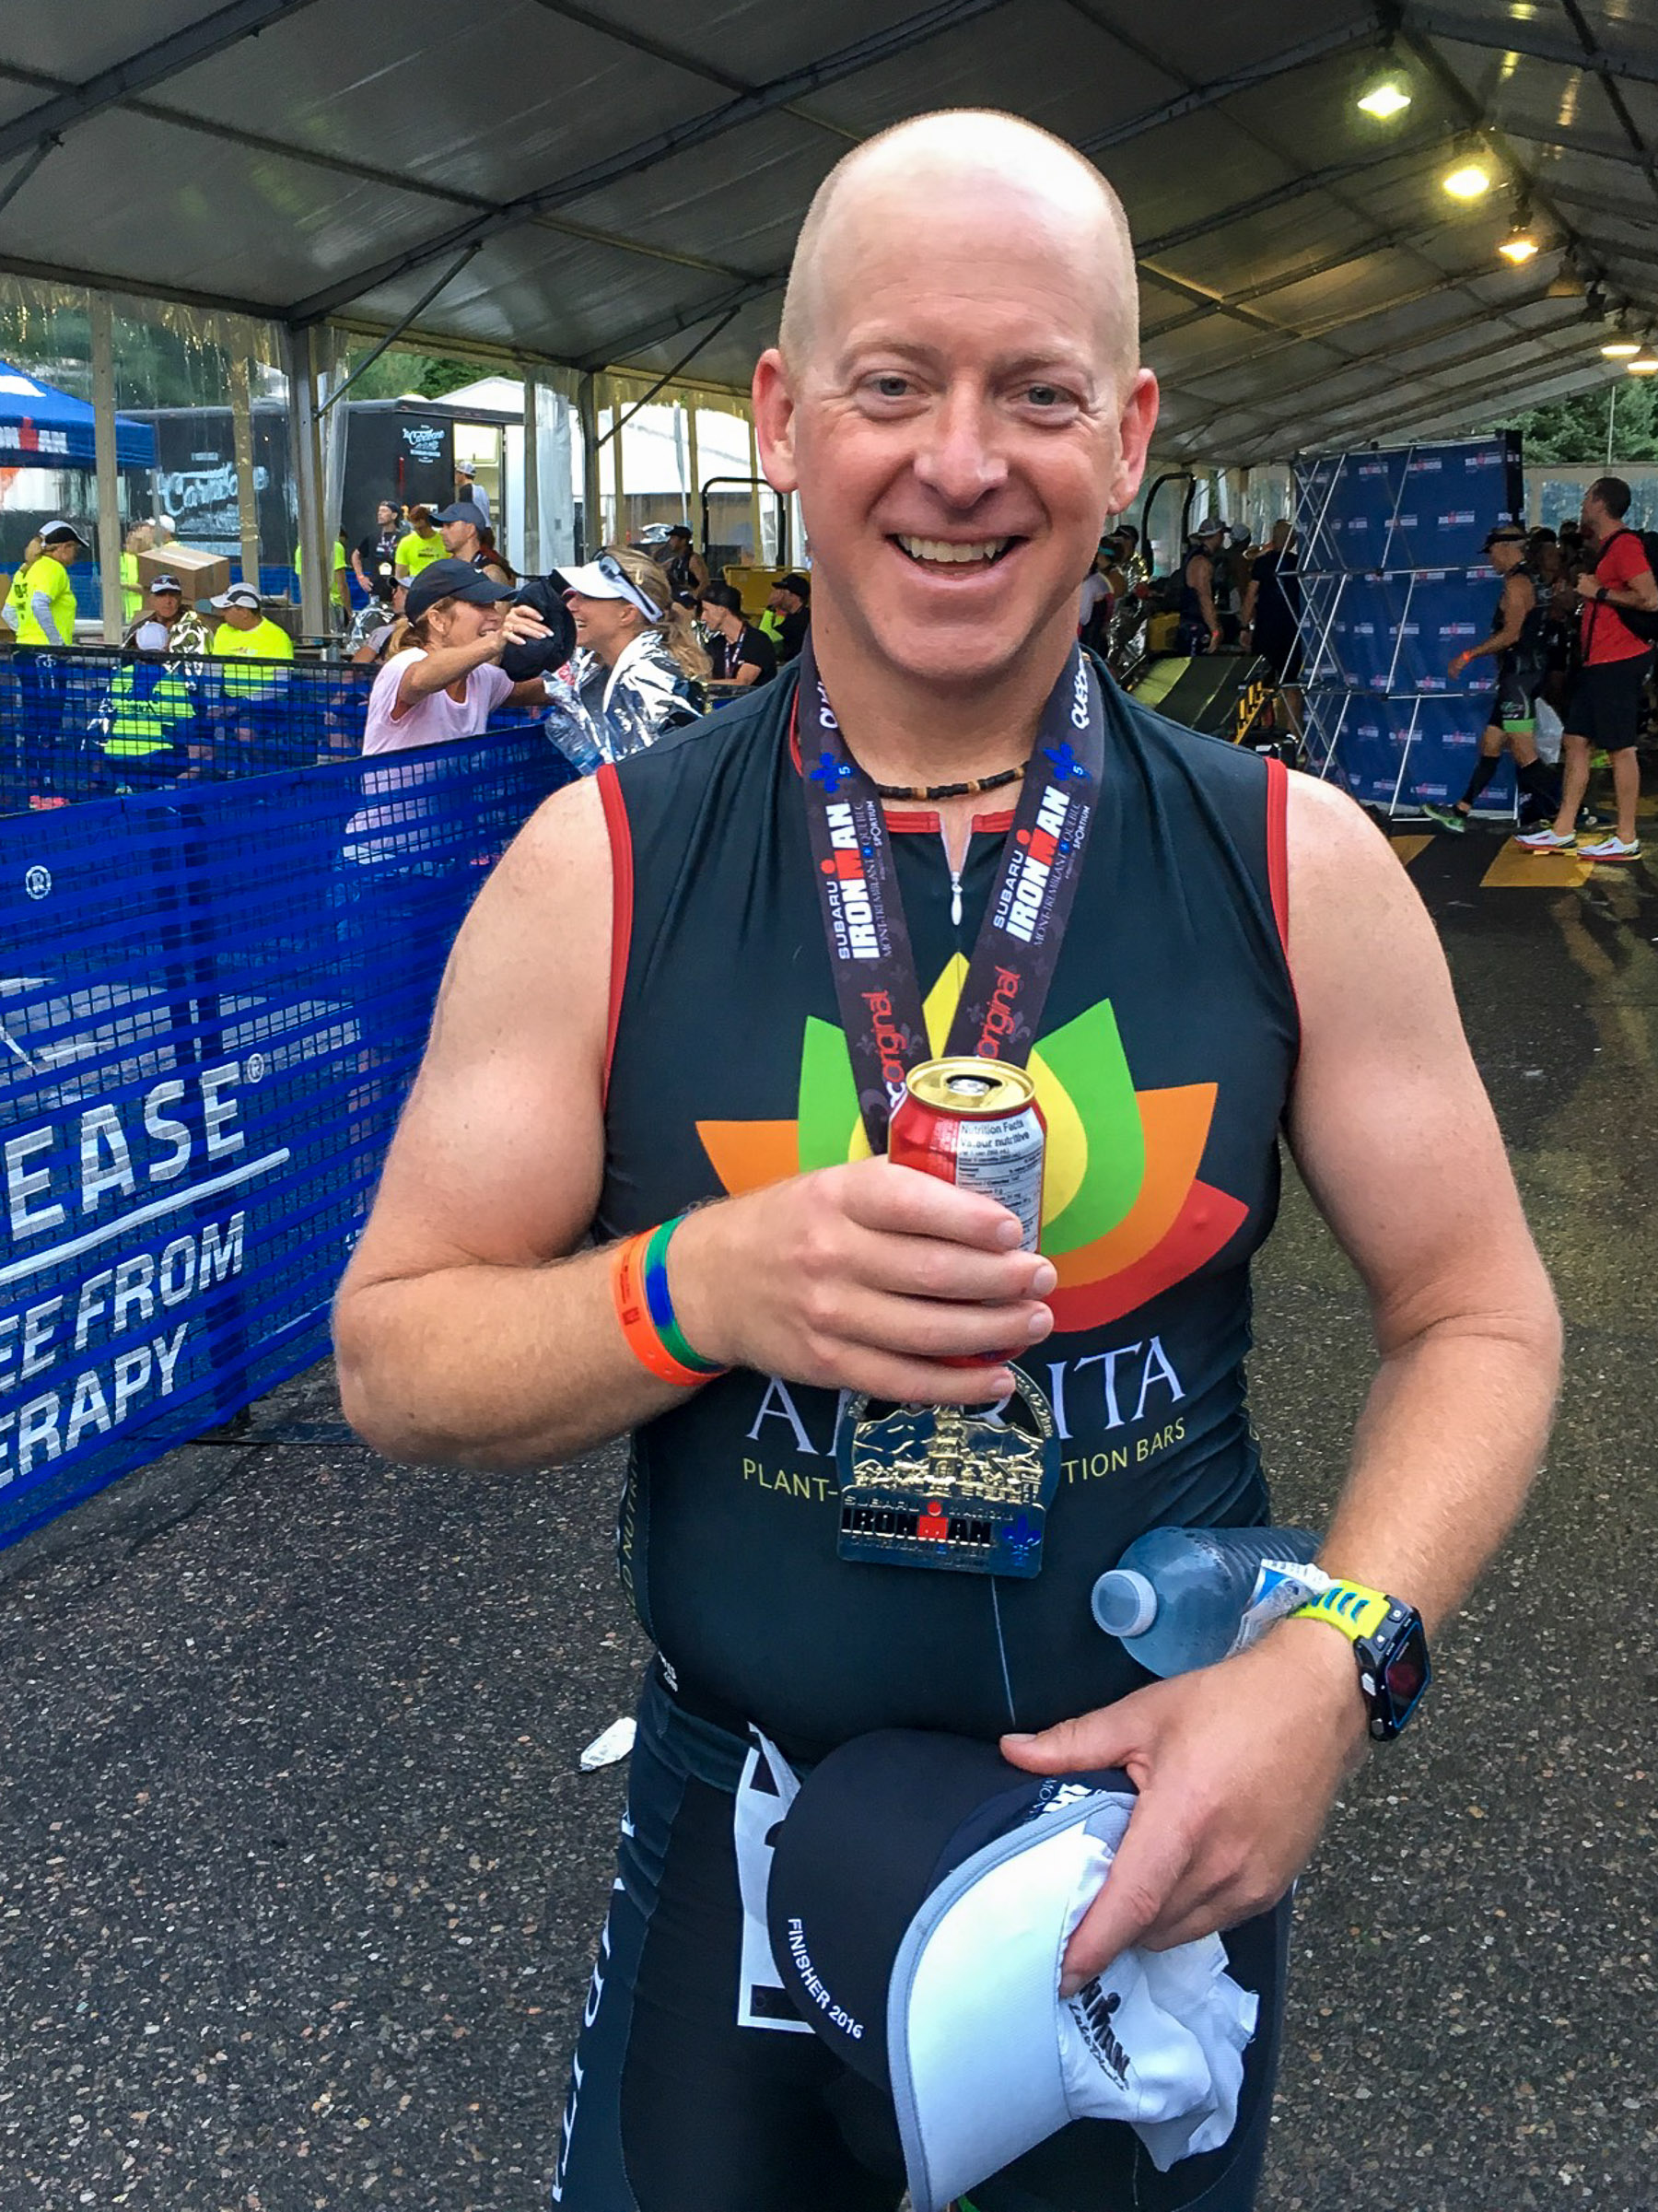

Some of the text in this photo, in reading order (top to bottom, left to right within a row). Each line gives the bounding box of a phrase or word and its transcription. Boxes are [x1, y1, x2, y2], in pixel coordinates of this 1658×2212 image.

[822, 802, 881, 959] IRONMAN
[993, 849, 1024, 930] SUBARU
[1006, 786, 1070, 942] IRONMAN
[826, 881, 851, 960] SUBARU
[861, 989, 907, 1083] original
[977, 966, 1021, 1059] original
[75, 1211, 246, 1351] FROM
[1136, 1417, 1185, 1462] BARS
[840, 1502, 993, 1549] IRONMAN
[788, 1918, 864, 2039] FINISHER 2016
